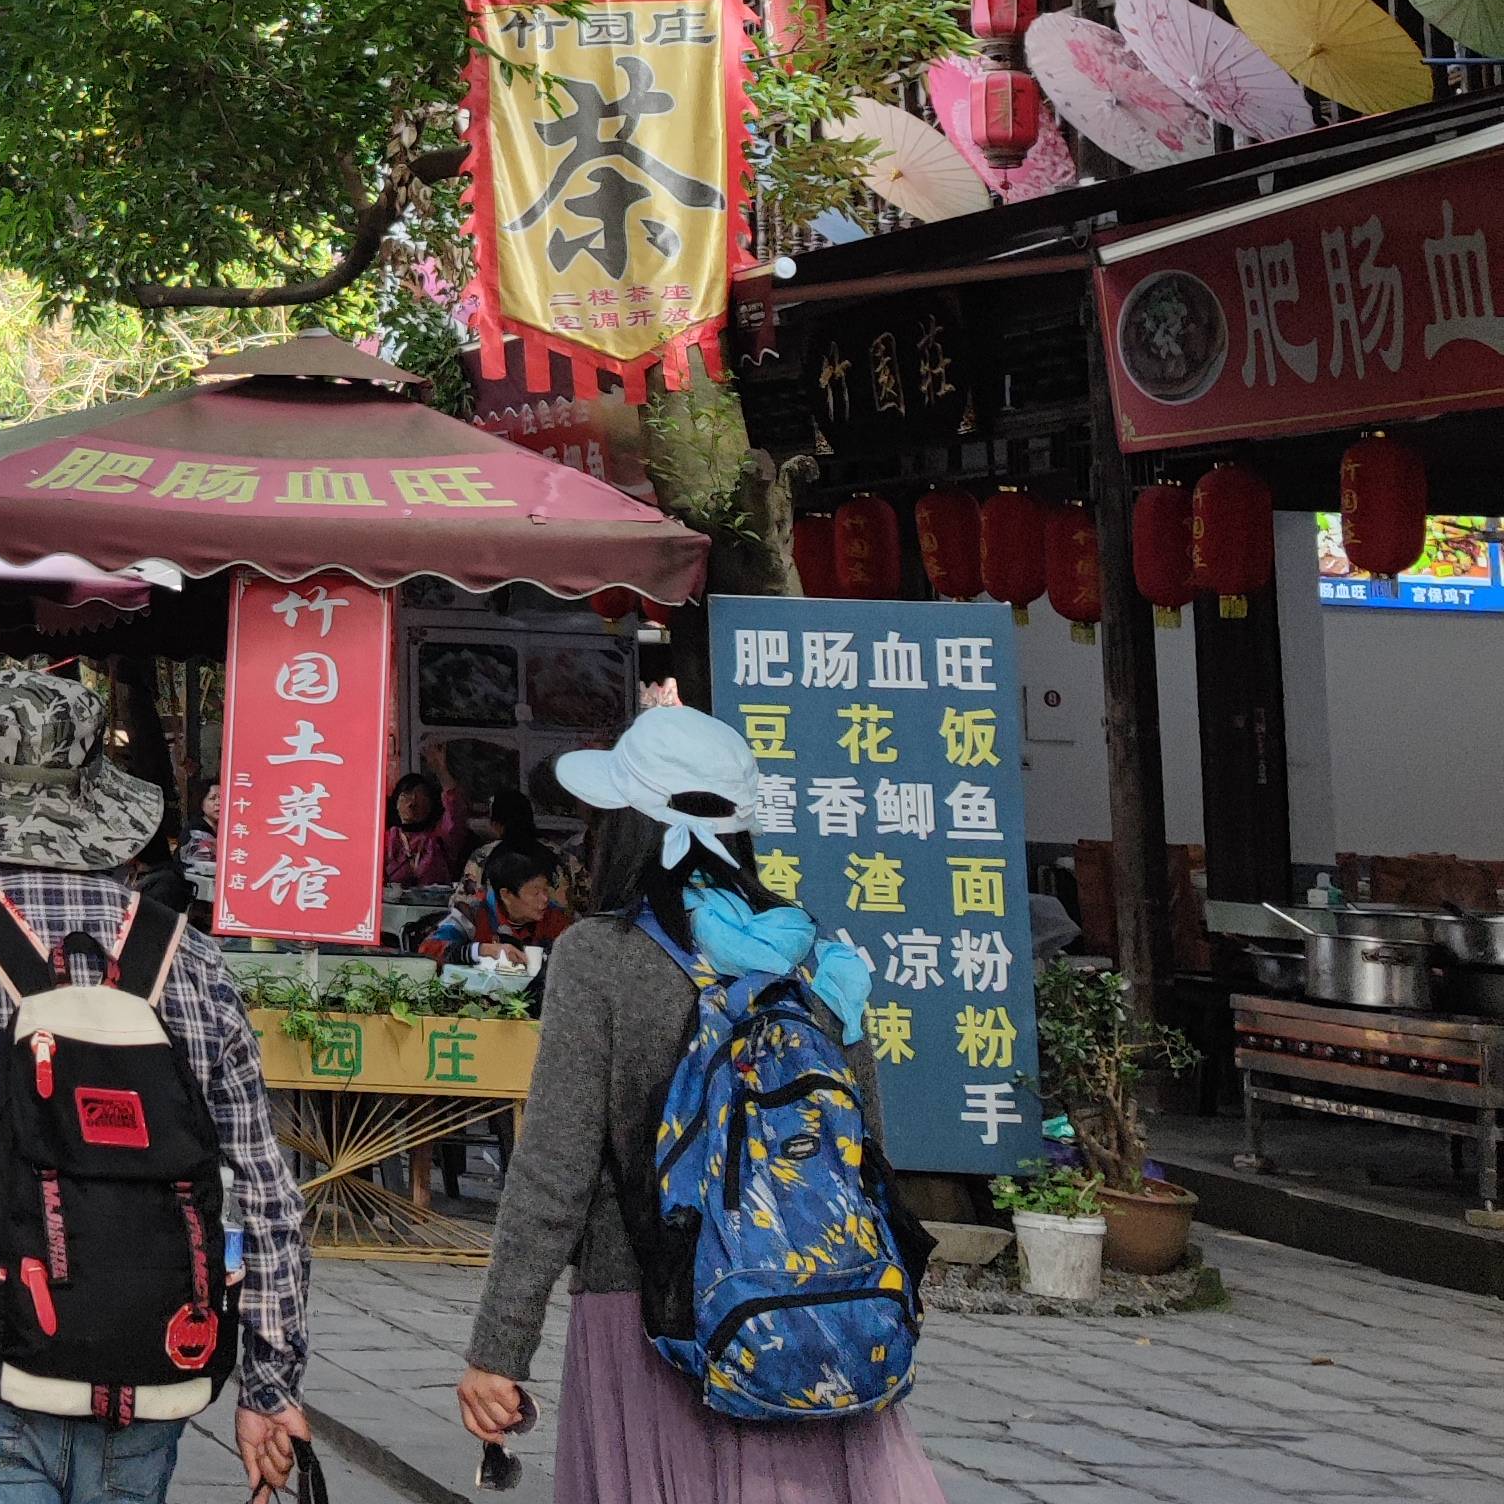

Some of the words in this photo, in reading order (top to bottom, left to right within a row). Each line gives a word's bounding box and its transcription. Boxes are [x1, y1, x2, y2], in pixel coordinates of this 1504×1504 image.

[500, 8, 717, 49] 竹园庄
[501, 55, 727, 282] 茶
[548, 285, 693, 309] 二楼茶座
[553, 308, 694, 331] 空调开放
[1234, 198, 1504, 390] 肥肠血
[26, 445, 518, 509] 肥肠血旺
[1411, 586, 1474, 605] 宫保鸡丁
[733, 628, 998, 692] 肥肠血旺
[250, 585, 350, 912] 竹园土菜馆
[739, 703, 1002, 768] 豆花饭
[226, 772, 254, 891] 三十年老店
[961, 1082, 1023, 1145] 手
